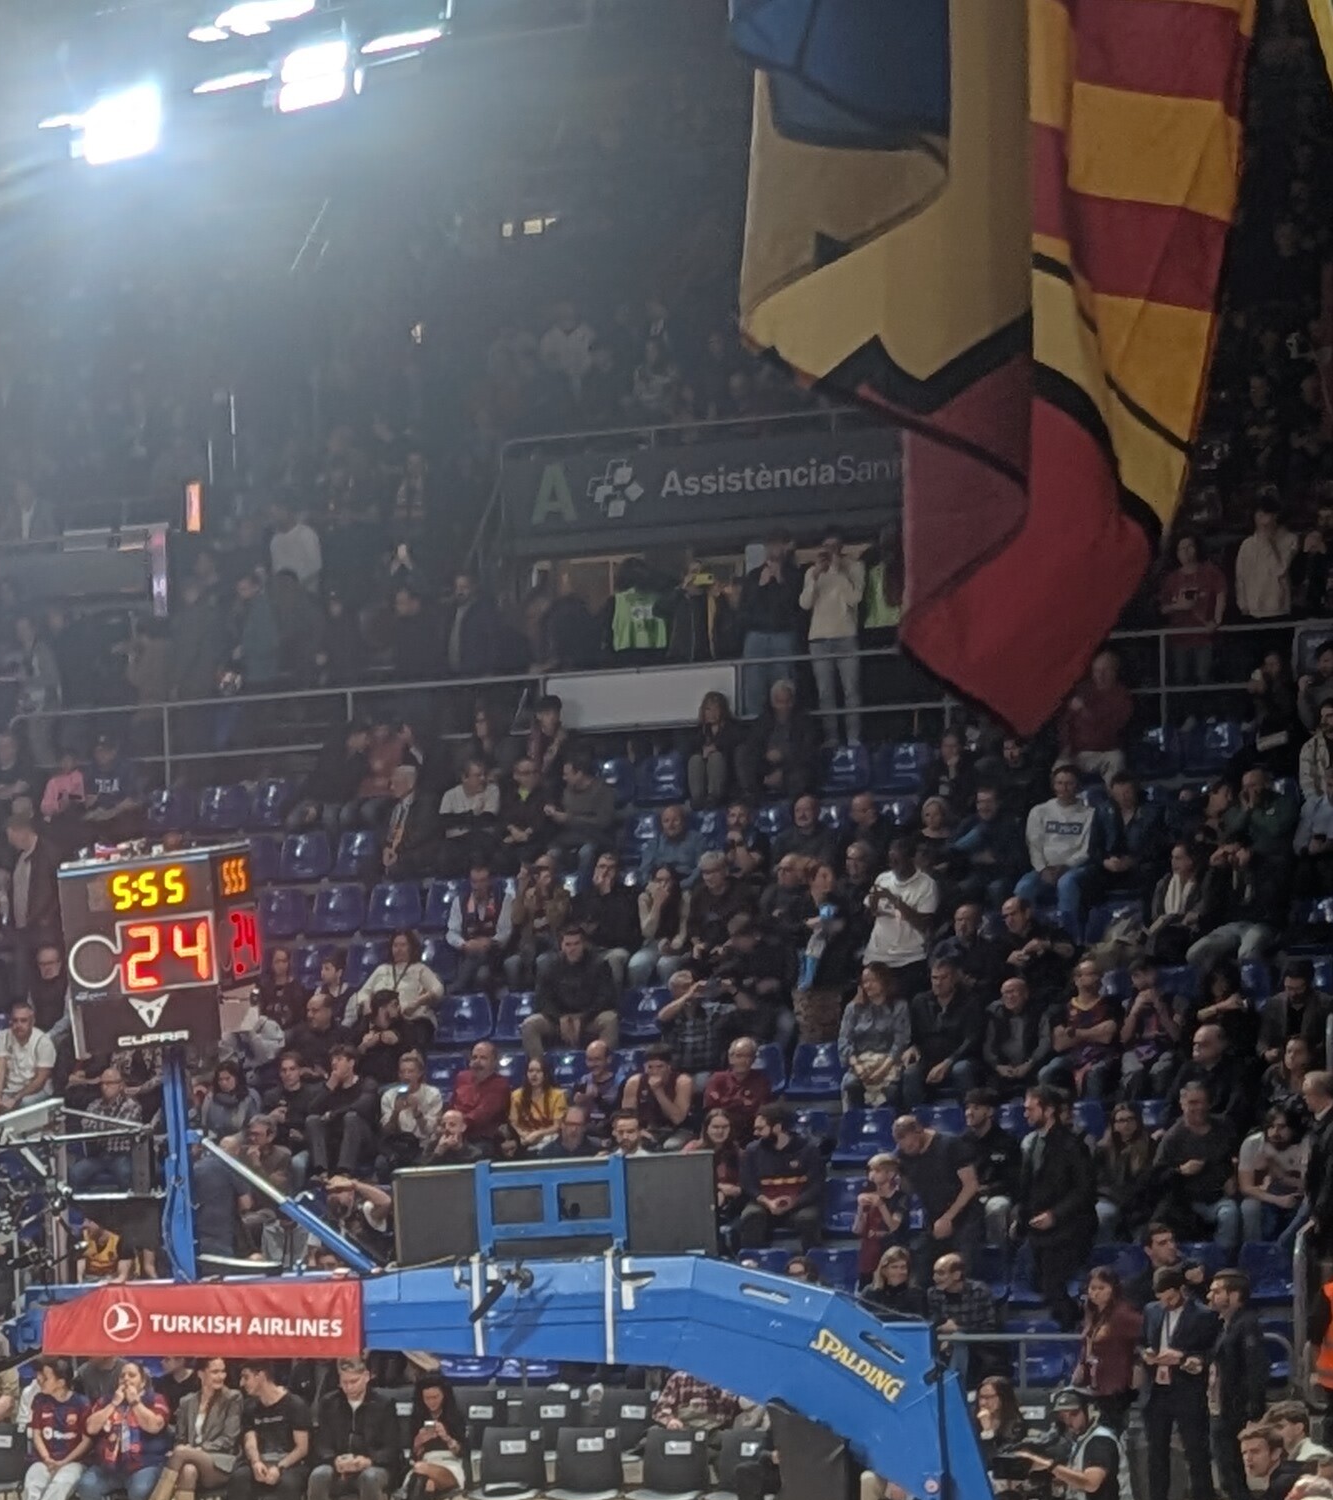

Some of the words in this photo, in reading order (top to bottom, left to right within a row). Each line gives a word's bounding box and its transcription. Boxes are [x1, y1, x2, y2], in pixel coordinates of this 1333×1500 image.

[660, 457, 834, 499] Assistència
[111, 867, 186, 911] 5:55
[125, 921, 210, 989] 24
[118, 1030, 190, 1047] CUPRA
[149, 1313, 243, 1336] TURKISH
[247, 1315, 343, 1338] AIRLINES
[810, 1328, 906, 1403] SPALDING
